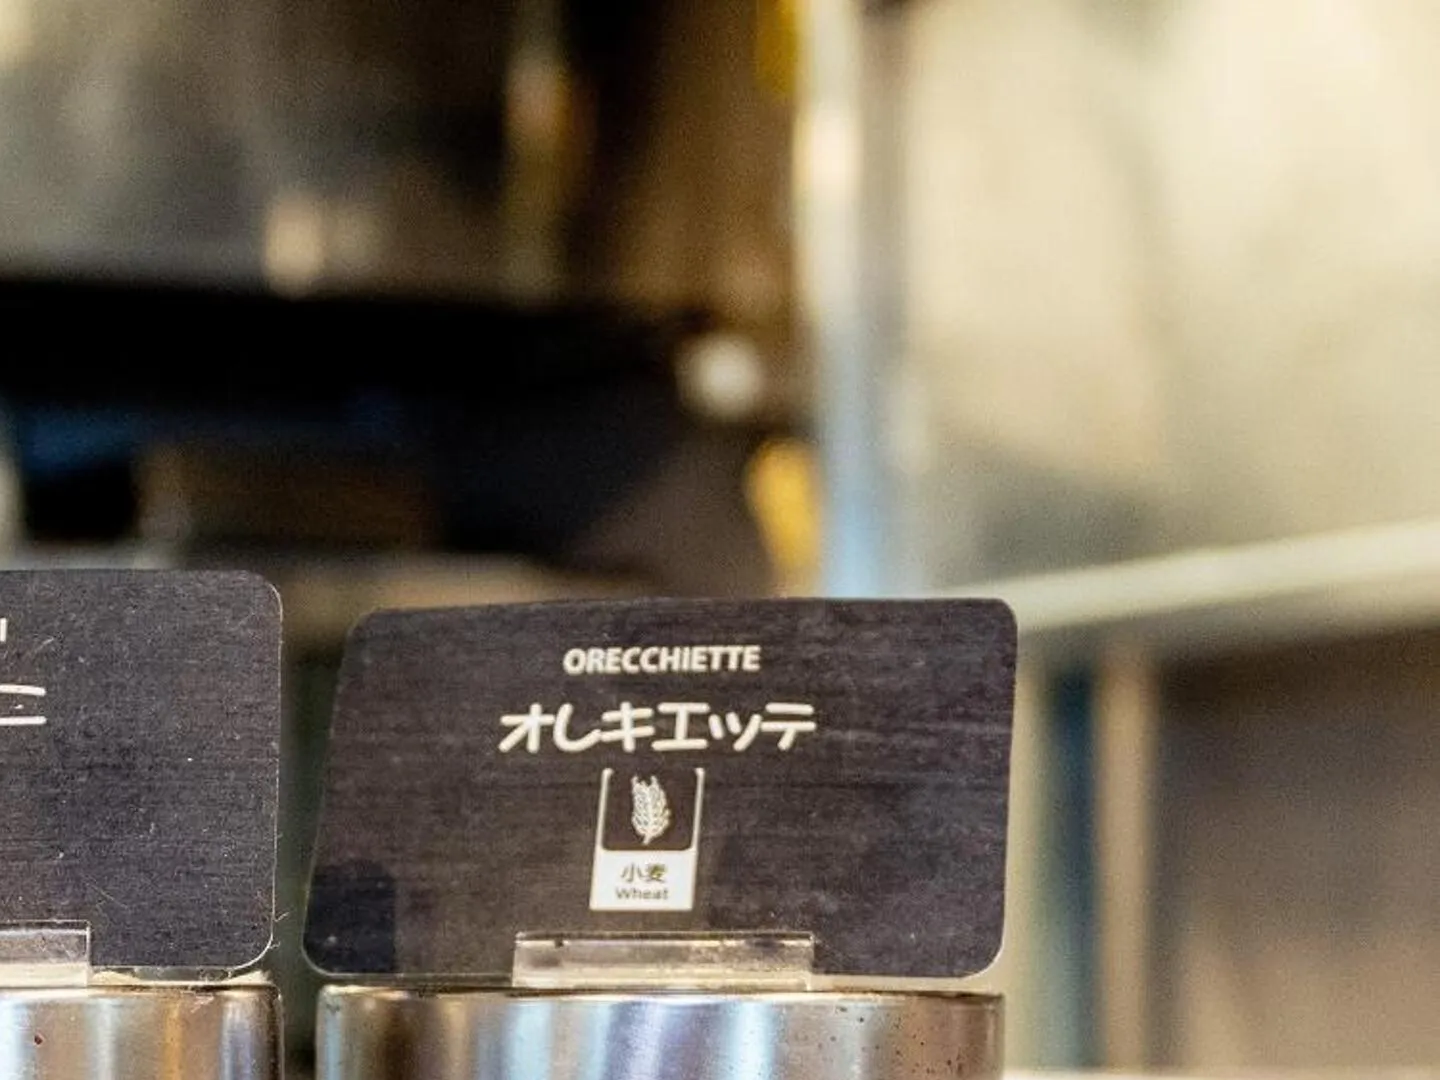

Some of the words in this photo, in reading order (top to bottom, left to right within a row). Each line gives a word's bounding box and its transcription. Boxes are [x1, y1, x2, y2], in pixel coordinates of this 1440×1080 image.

[562, 644, 761, 676] ORECCHIETTE
[498, 702, 817, 753] オレキエッテ
[620, 862, 668, 884] 小麦
[614, 885, 669, 902] Wheat
